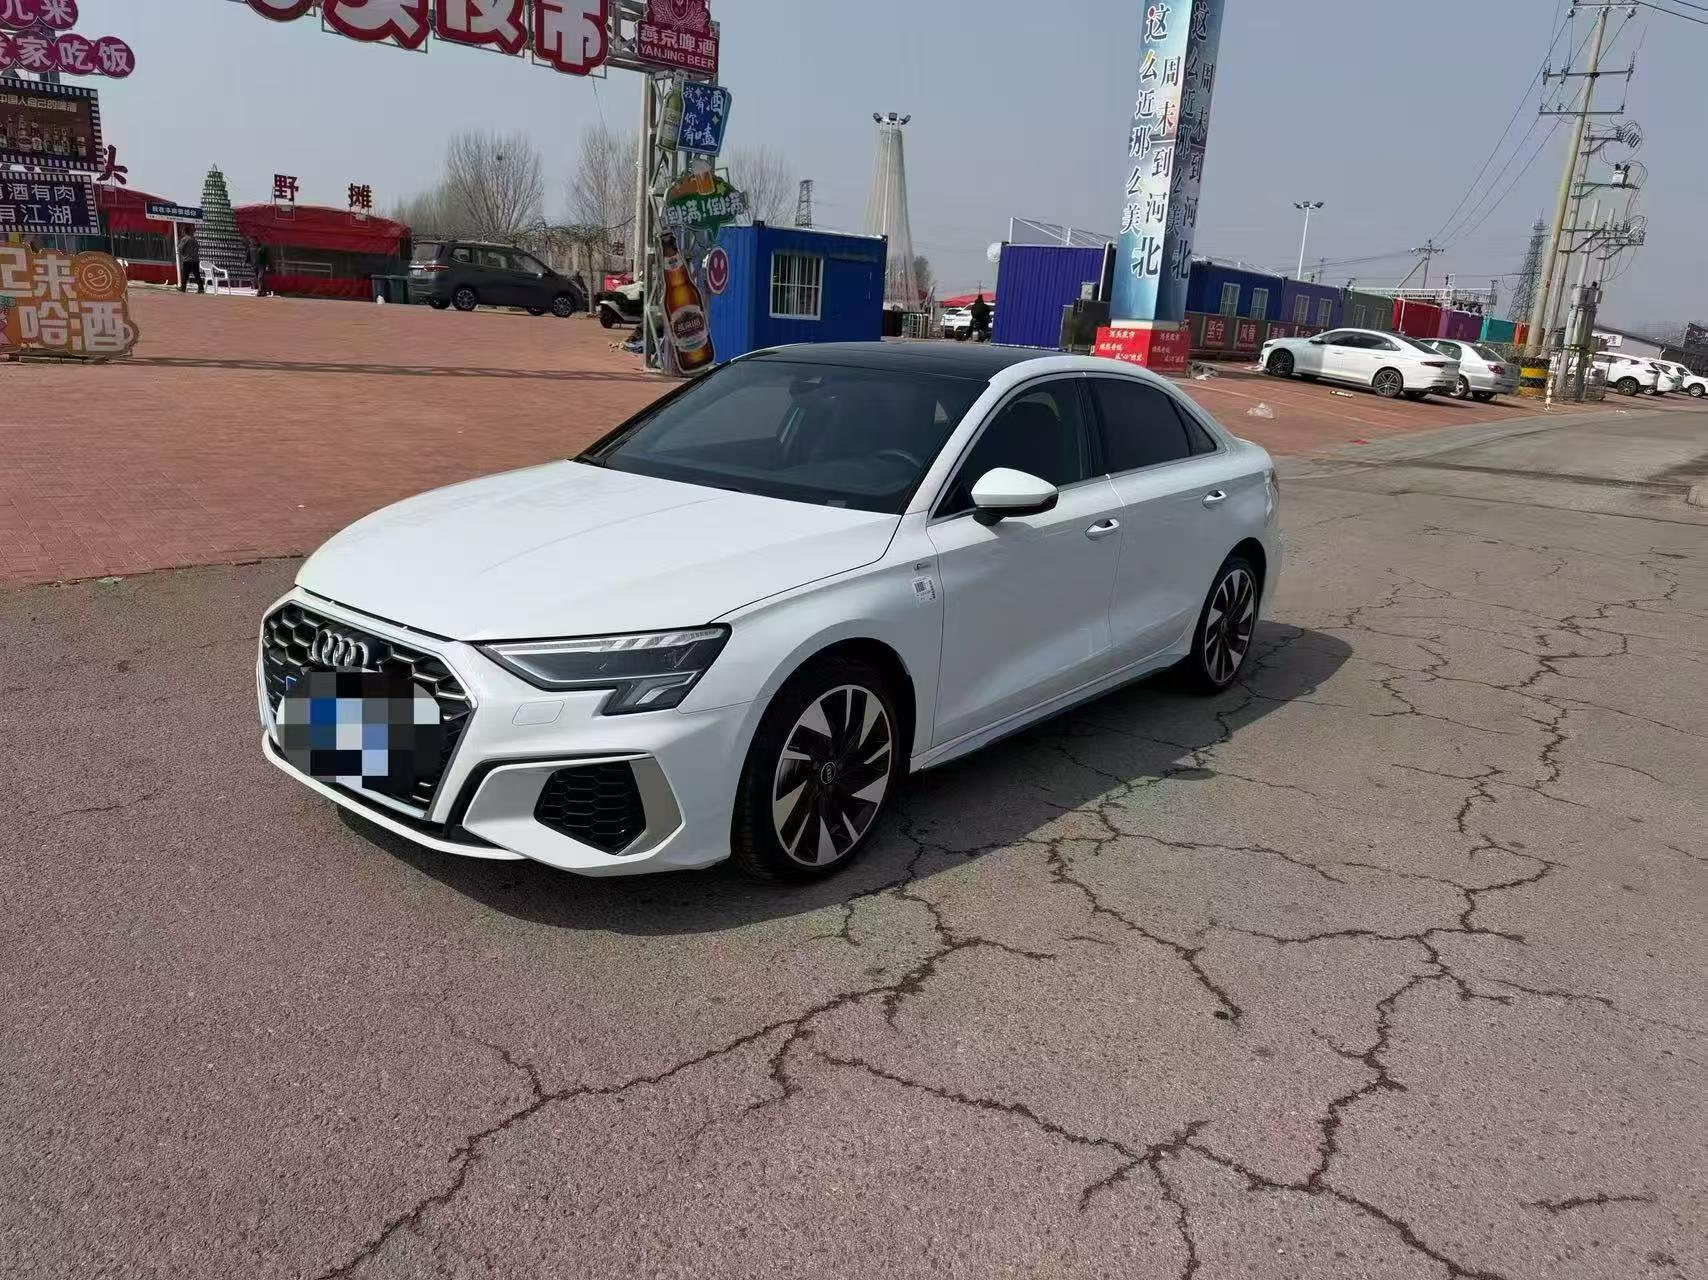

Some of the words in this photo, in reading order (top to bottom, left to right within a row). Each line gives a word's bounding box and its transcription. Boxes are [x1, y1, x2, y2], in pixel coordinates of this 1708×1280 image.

[640, 44, 685, 62] YANJING
[687, 55, 715, 69] BEER
[641, 24, 716, 57] 燕京啤酒
[1120, 4, 1170, 238] 这么近那么美
[1131, 56, 1182, 279] 周末到河北
[1166, 2, 1210, 239] 这么近那么美
[1171, 62, 1215, 280] 周末到河北
[0, 183, 75, 202] 酒有肉
[18, 300, 134, 352] 哈酒
